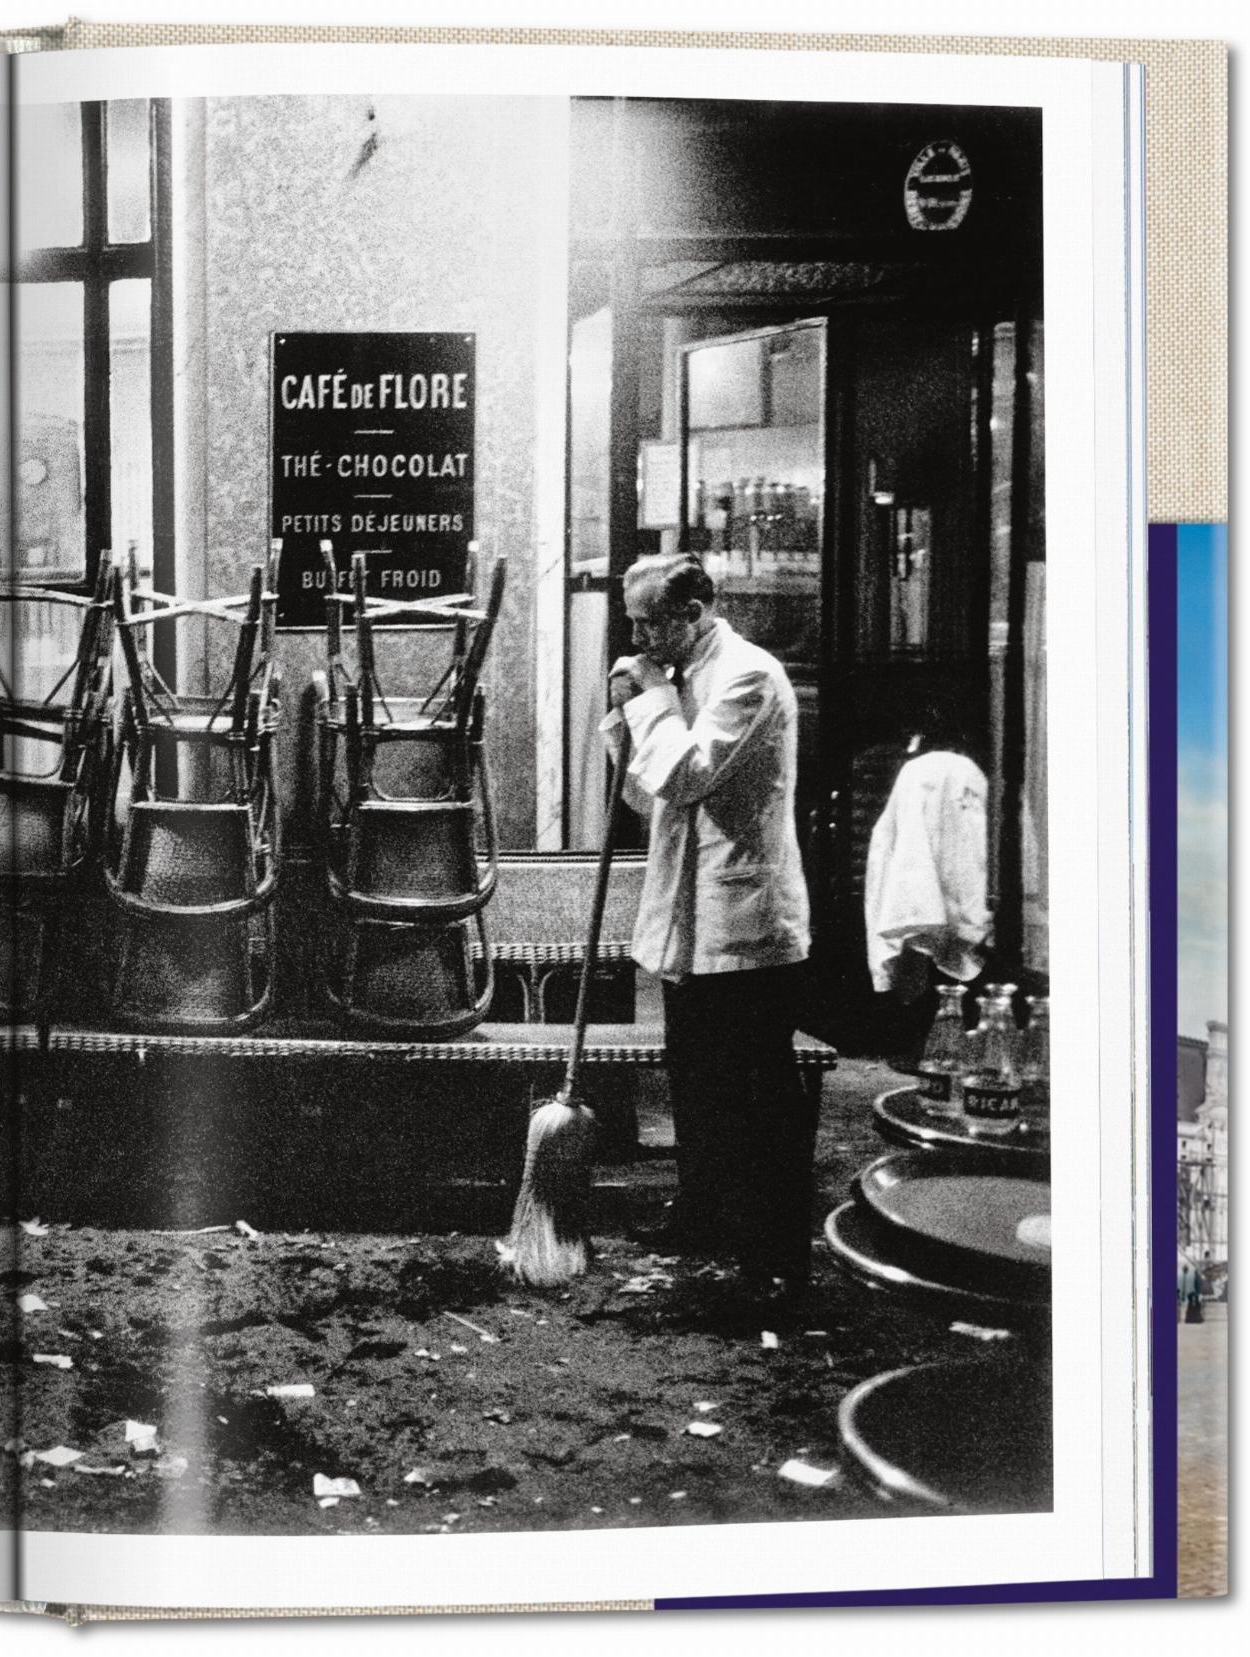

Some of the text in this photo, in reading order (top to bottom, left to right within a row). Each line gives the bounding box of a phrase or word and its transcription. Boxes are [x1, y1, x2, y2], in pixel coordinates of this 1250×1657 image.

[281, 368, 347, 410] CAFÉ
[379, 373, 467, 409] FLORE
[282, 511, 464, 533] PETITS DÉJEUNERS
[381, 569, 442, 588] FROID
